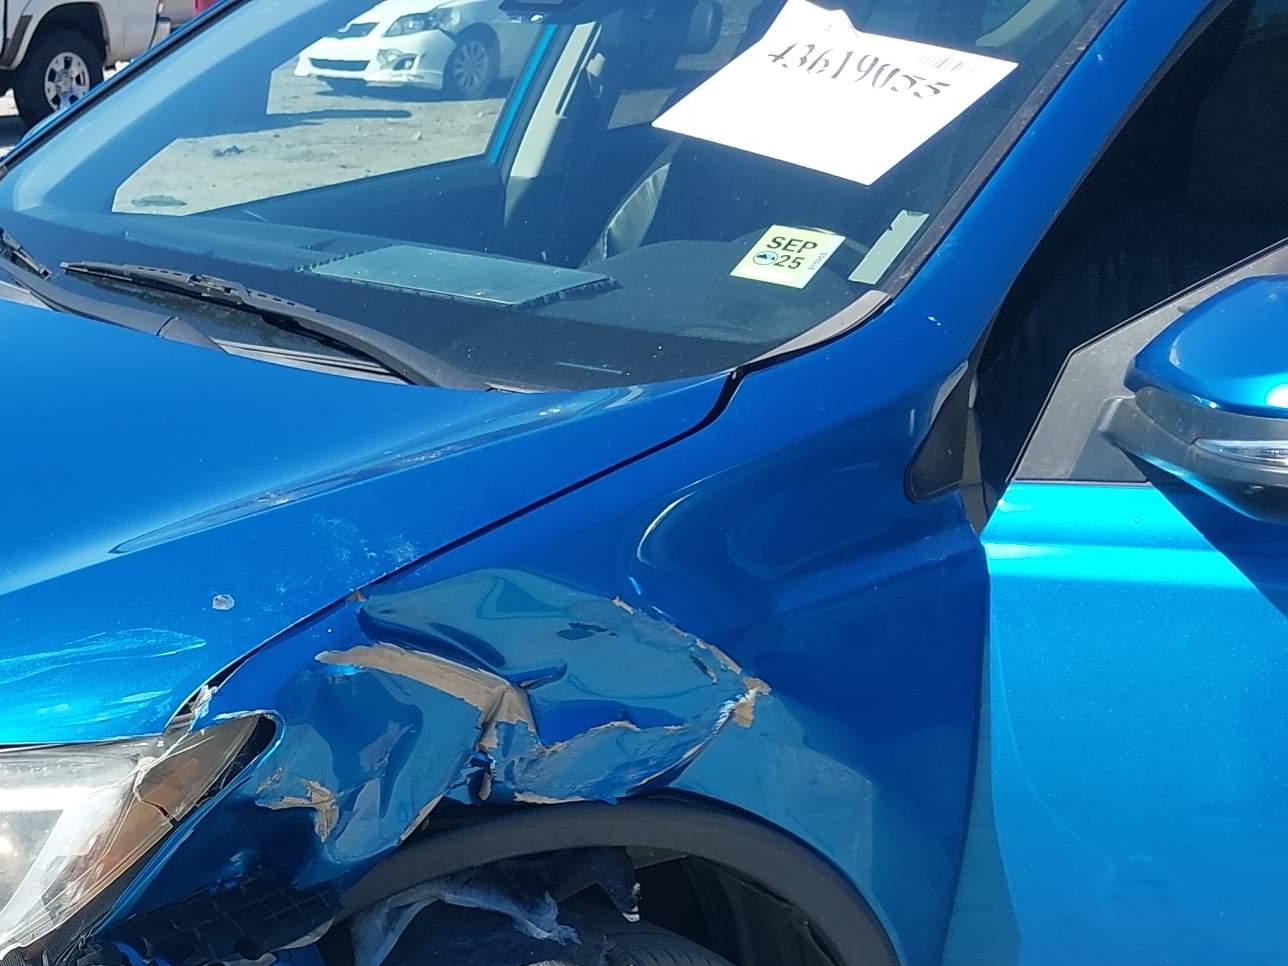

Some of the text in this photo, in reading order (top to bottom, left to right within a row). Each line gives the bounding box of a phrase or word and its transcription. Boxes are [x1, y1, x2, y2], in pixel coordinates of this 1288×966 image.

[768, 42, 951, 99] 43619055
[766, 236, 818, 253] SEP
[773, 254, 805, 270] 25
